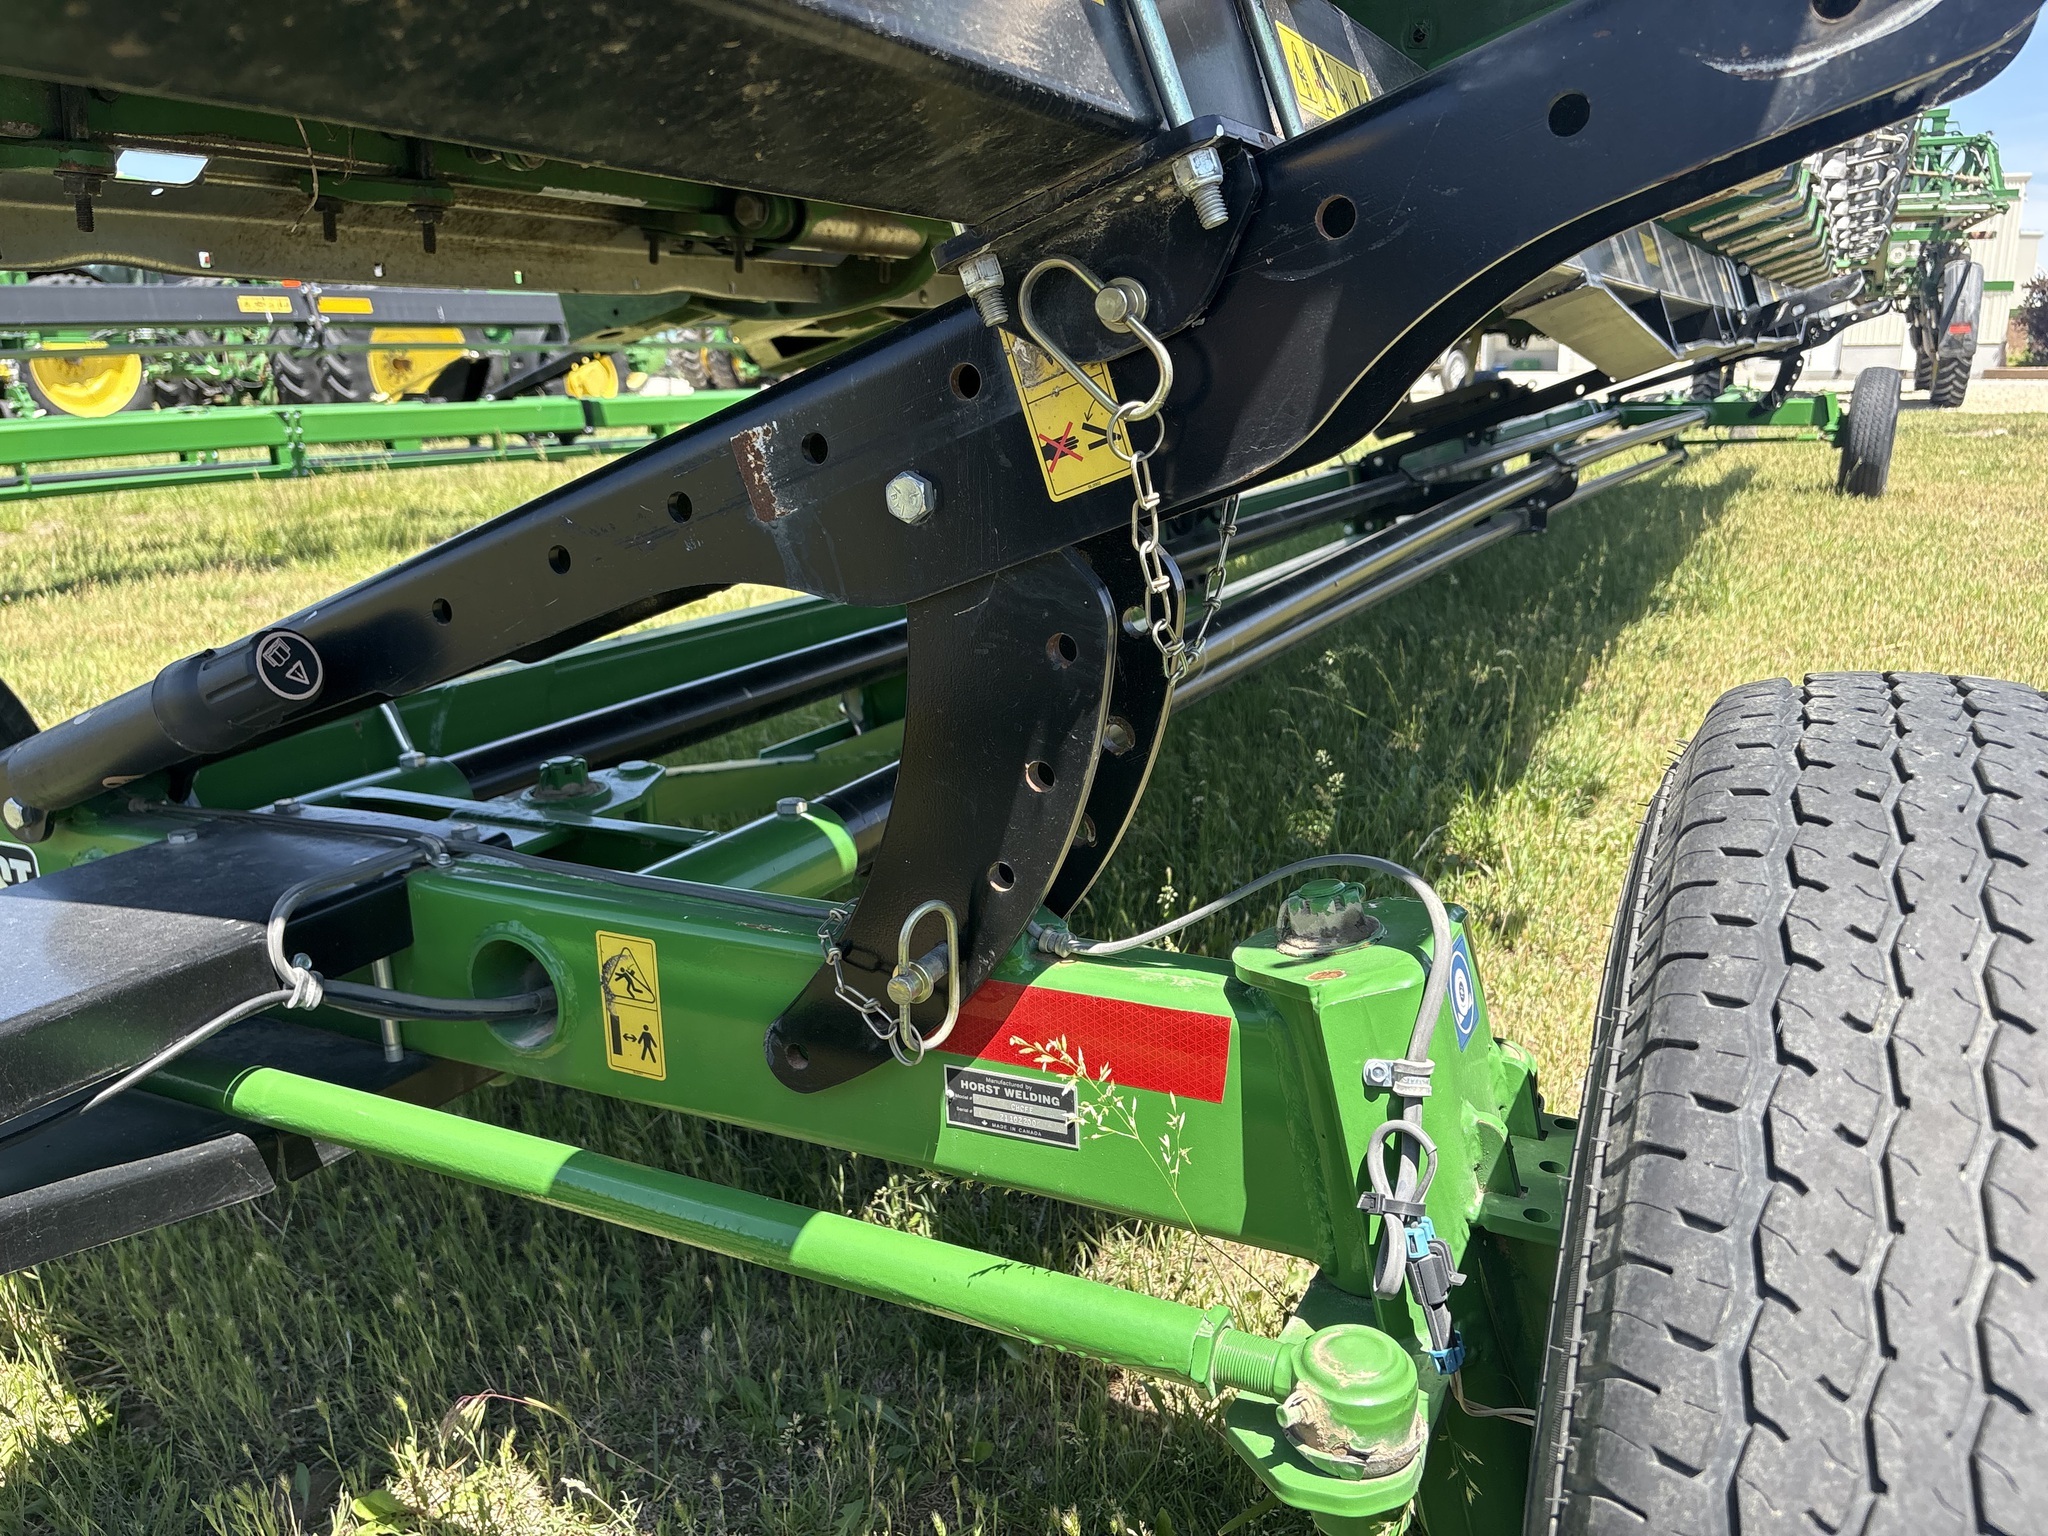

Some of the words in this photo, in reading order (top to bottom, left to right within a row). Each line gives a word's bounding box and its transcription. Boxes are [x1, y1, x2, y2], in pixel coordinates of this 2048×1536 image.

[985, 1077, 1024, 1089] Manufactured
[960, 1079, 1000, 1095] HORST
[1004, 1087, 1060, 1106] WELDING
[991, 1122, 1008, 1130] MADE
[1018, 1127, 1042, 1137] CANADA
